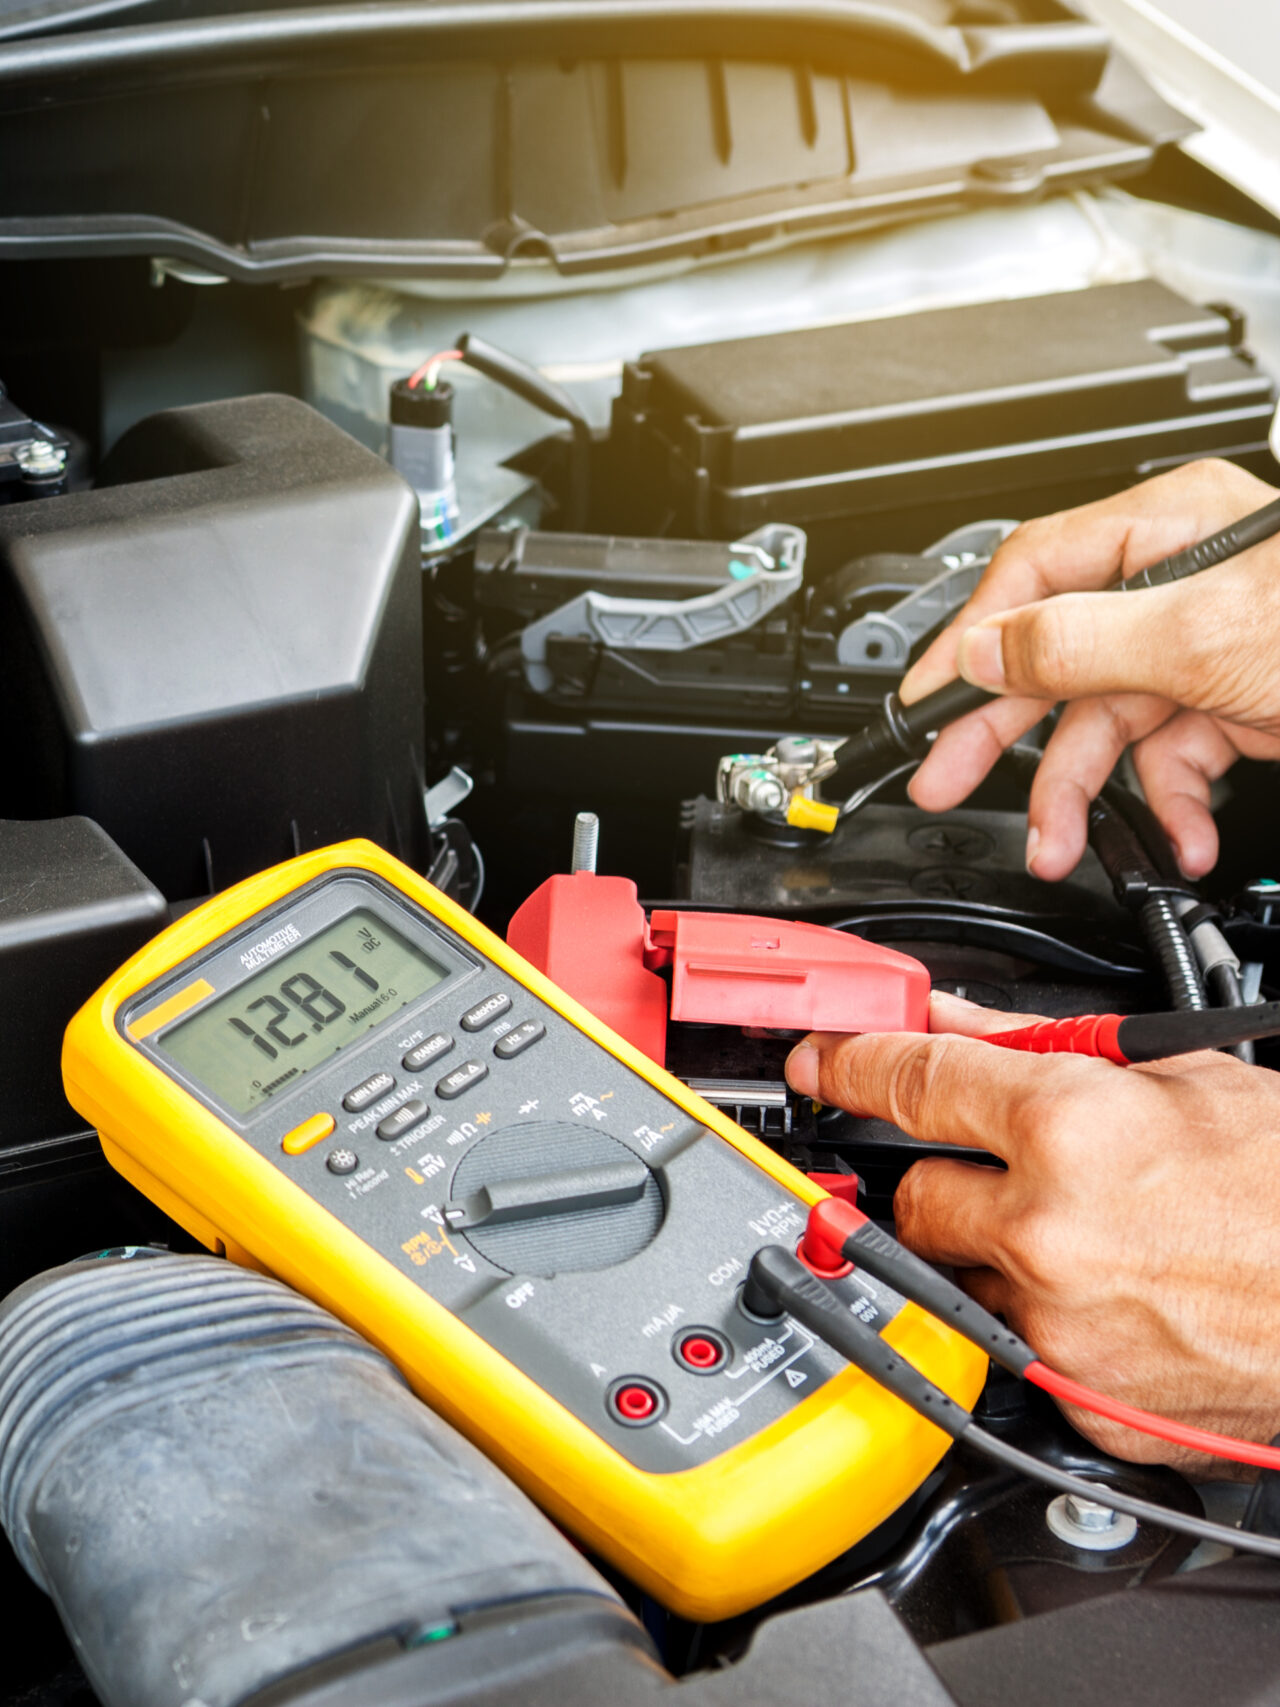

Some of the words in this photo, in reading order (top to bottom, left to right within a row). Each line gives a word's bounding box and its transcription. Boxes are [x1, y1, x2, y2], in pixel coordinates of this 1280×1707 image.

[240, 923, 297, 964] AUTOMOTIVE
[358, 927, 372, 938] V
[363, 938, 381, 951] DC
[245, 928, 302, 970] MULTIMETER
[349, 997, 383, 1023] Manual
[468, 993, 508, 1023] AutoHOLD
[493, 1022, 512, 1036] ms
[505, 1033, 522, 1046] Hz
[412, 1035, 447, 1061] RANGE
[350, 1086, 370, 1104] MIN
[367, 1073, 391, 1092] MAX
[447, 1071, 469, 1087] REL
[348, 1106, 378, 1134] PEAK
[376, 1096, 400, 1115] MIN
[396, 1080, 424, 1101] MAX
[396, 1114, 447, 1150] TRIGGER
[770, 1212, 804, 1239] RPM
[708, 1257, 744, 1286] COM
[505, 1281, 534, 1308] OFF
[642, 1316, 667, 1338] mA
[589, 1362, 607, 1378] A
[751, 1345, 785, 1373] FUSED
[705, 1408, 740, 1437] FUSED
